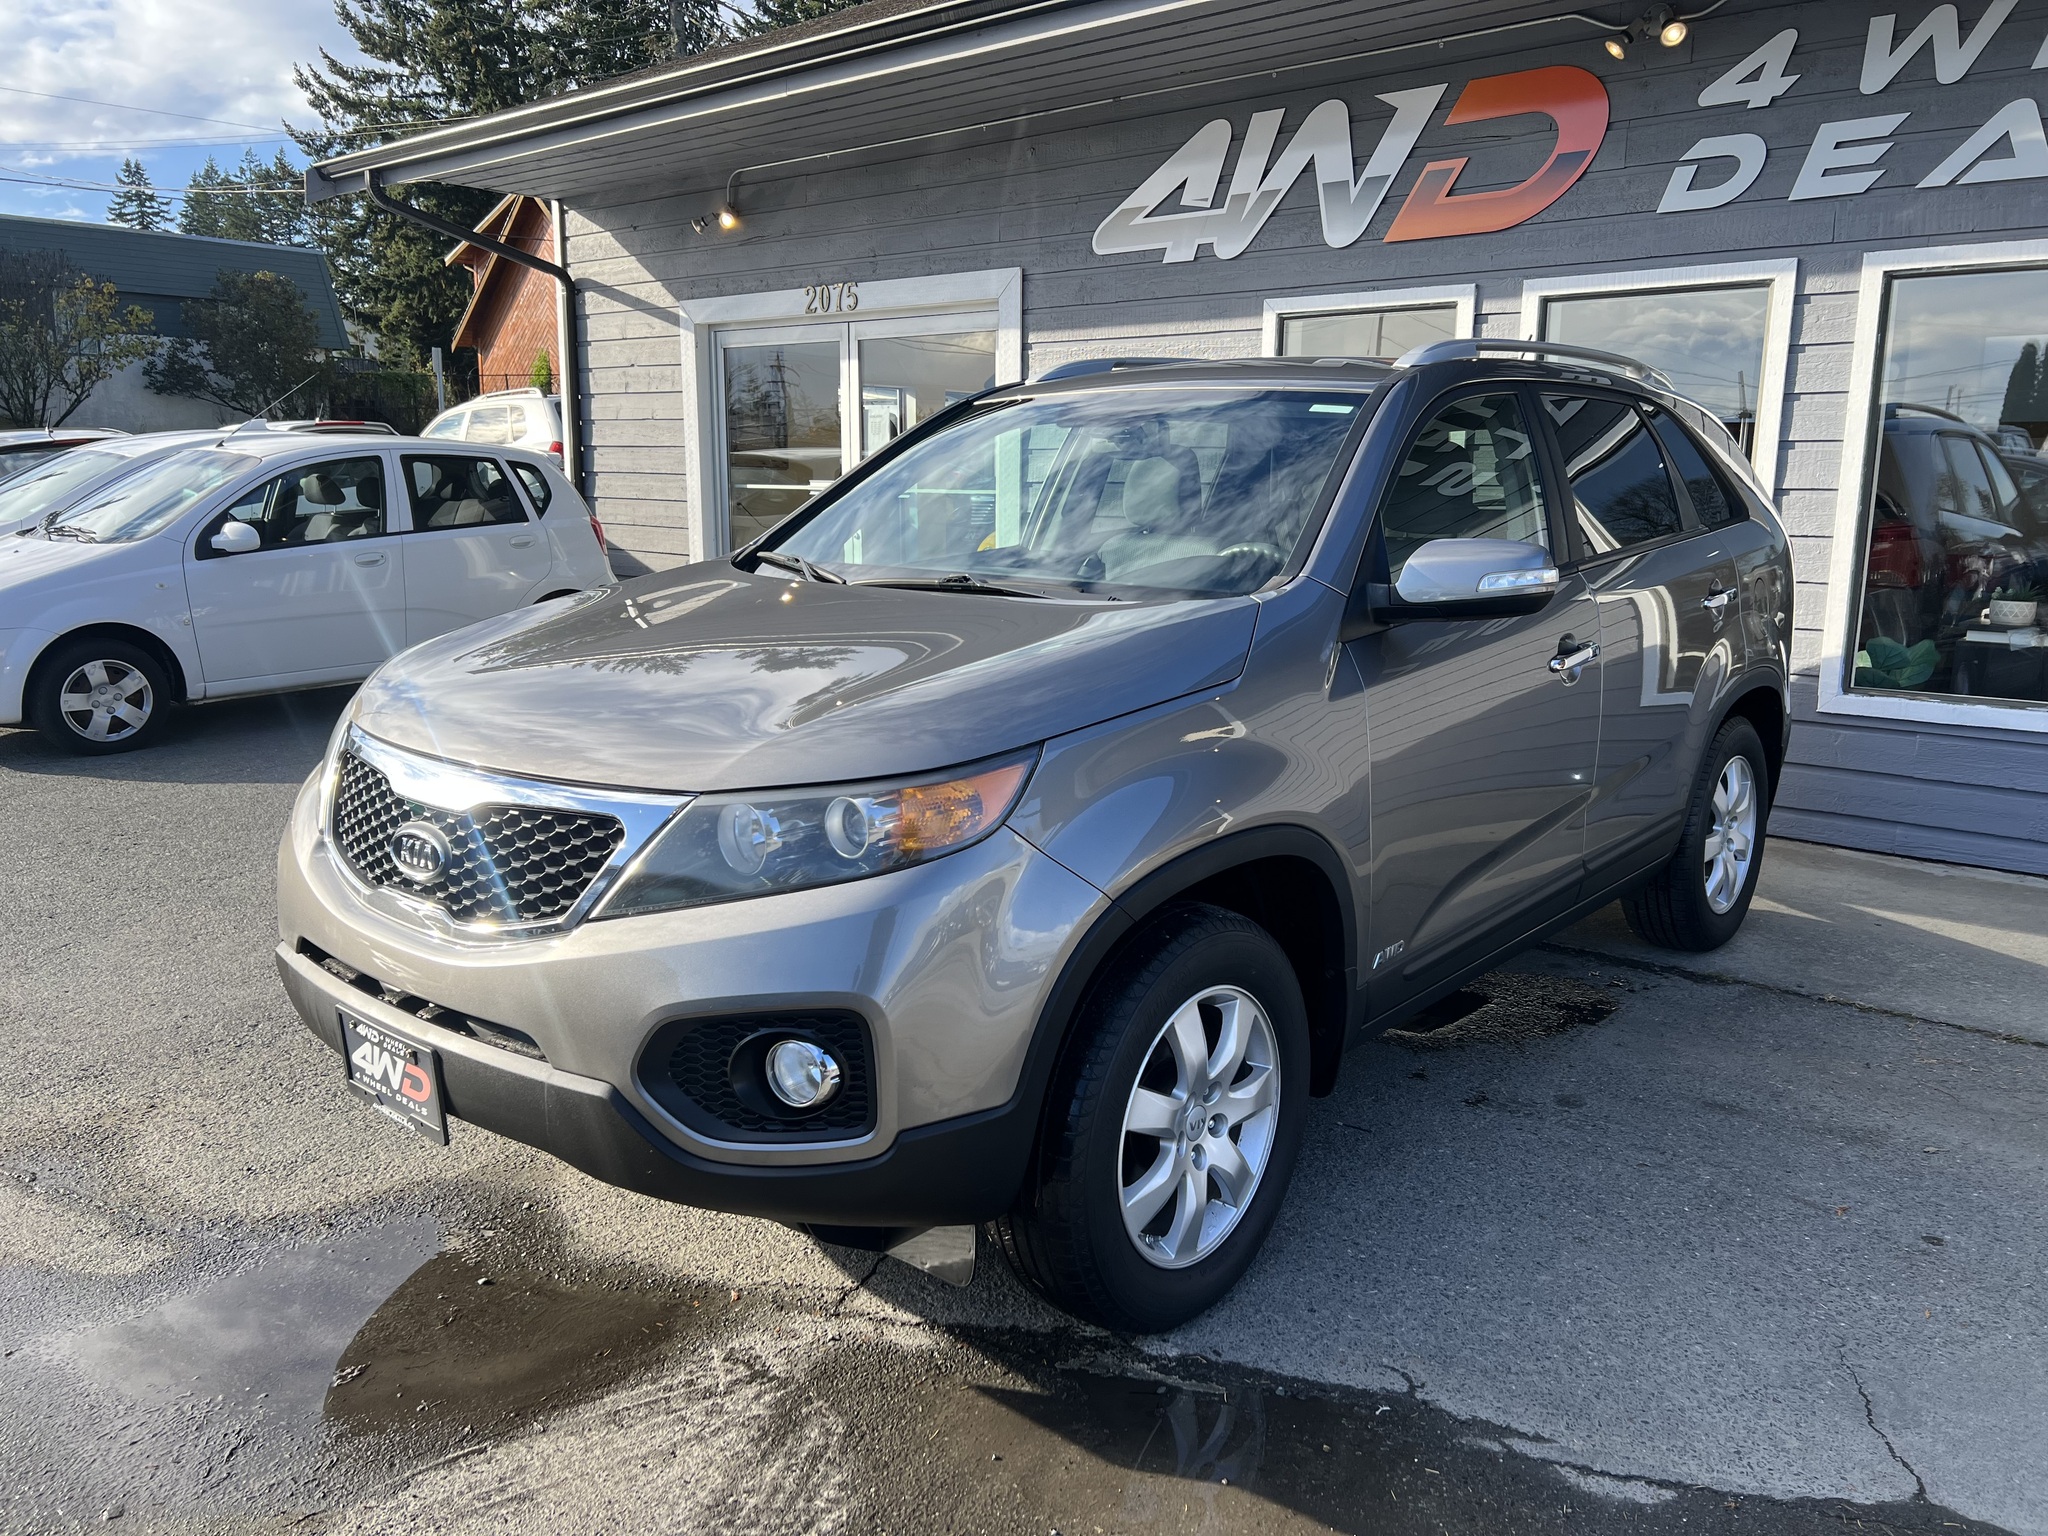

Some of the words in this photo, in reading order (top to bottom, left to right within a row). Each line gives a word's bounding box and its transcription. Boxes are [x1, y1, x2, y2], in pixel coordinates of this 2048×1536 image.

[1698, 29, 1801, 109] 4
[1859, 0, 2048, 95] W
[1092, 66, 1610, 264] 4WD
[804, 282, 859, 315] 2075
[400, 836, 434, 871] KIA
[356, 1023, 380, 1043] 4WD
[351, 1041, 431, 1103] 4WD
[354, 1071, 361, 1079] 4
[362, 1074, 393, 1097] WHEEL
[395, 1093, 428, 1116] DEALS
[1189, 1116, 1207, 1132] KIA
